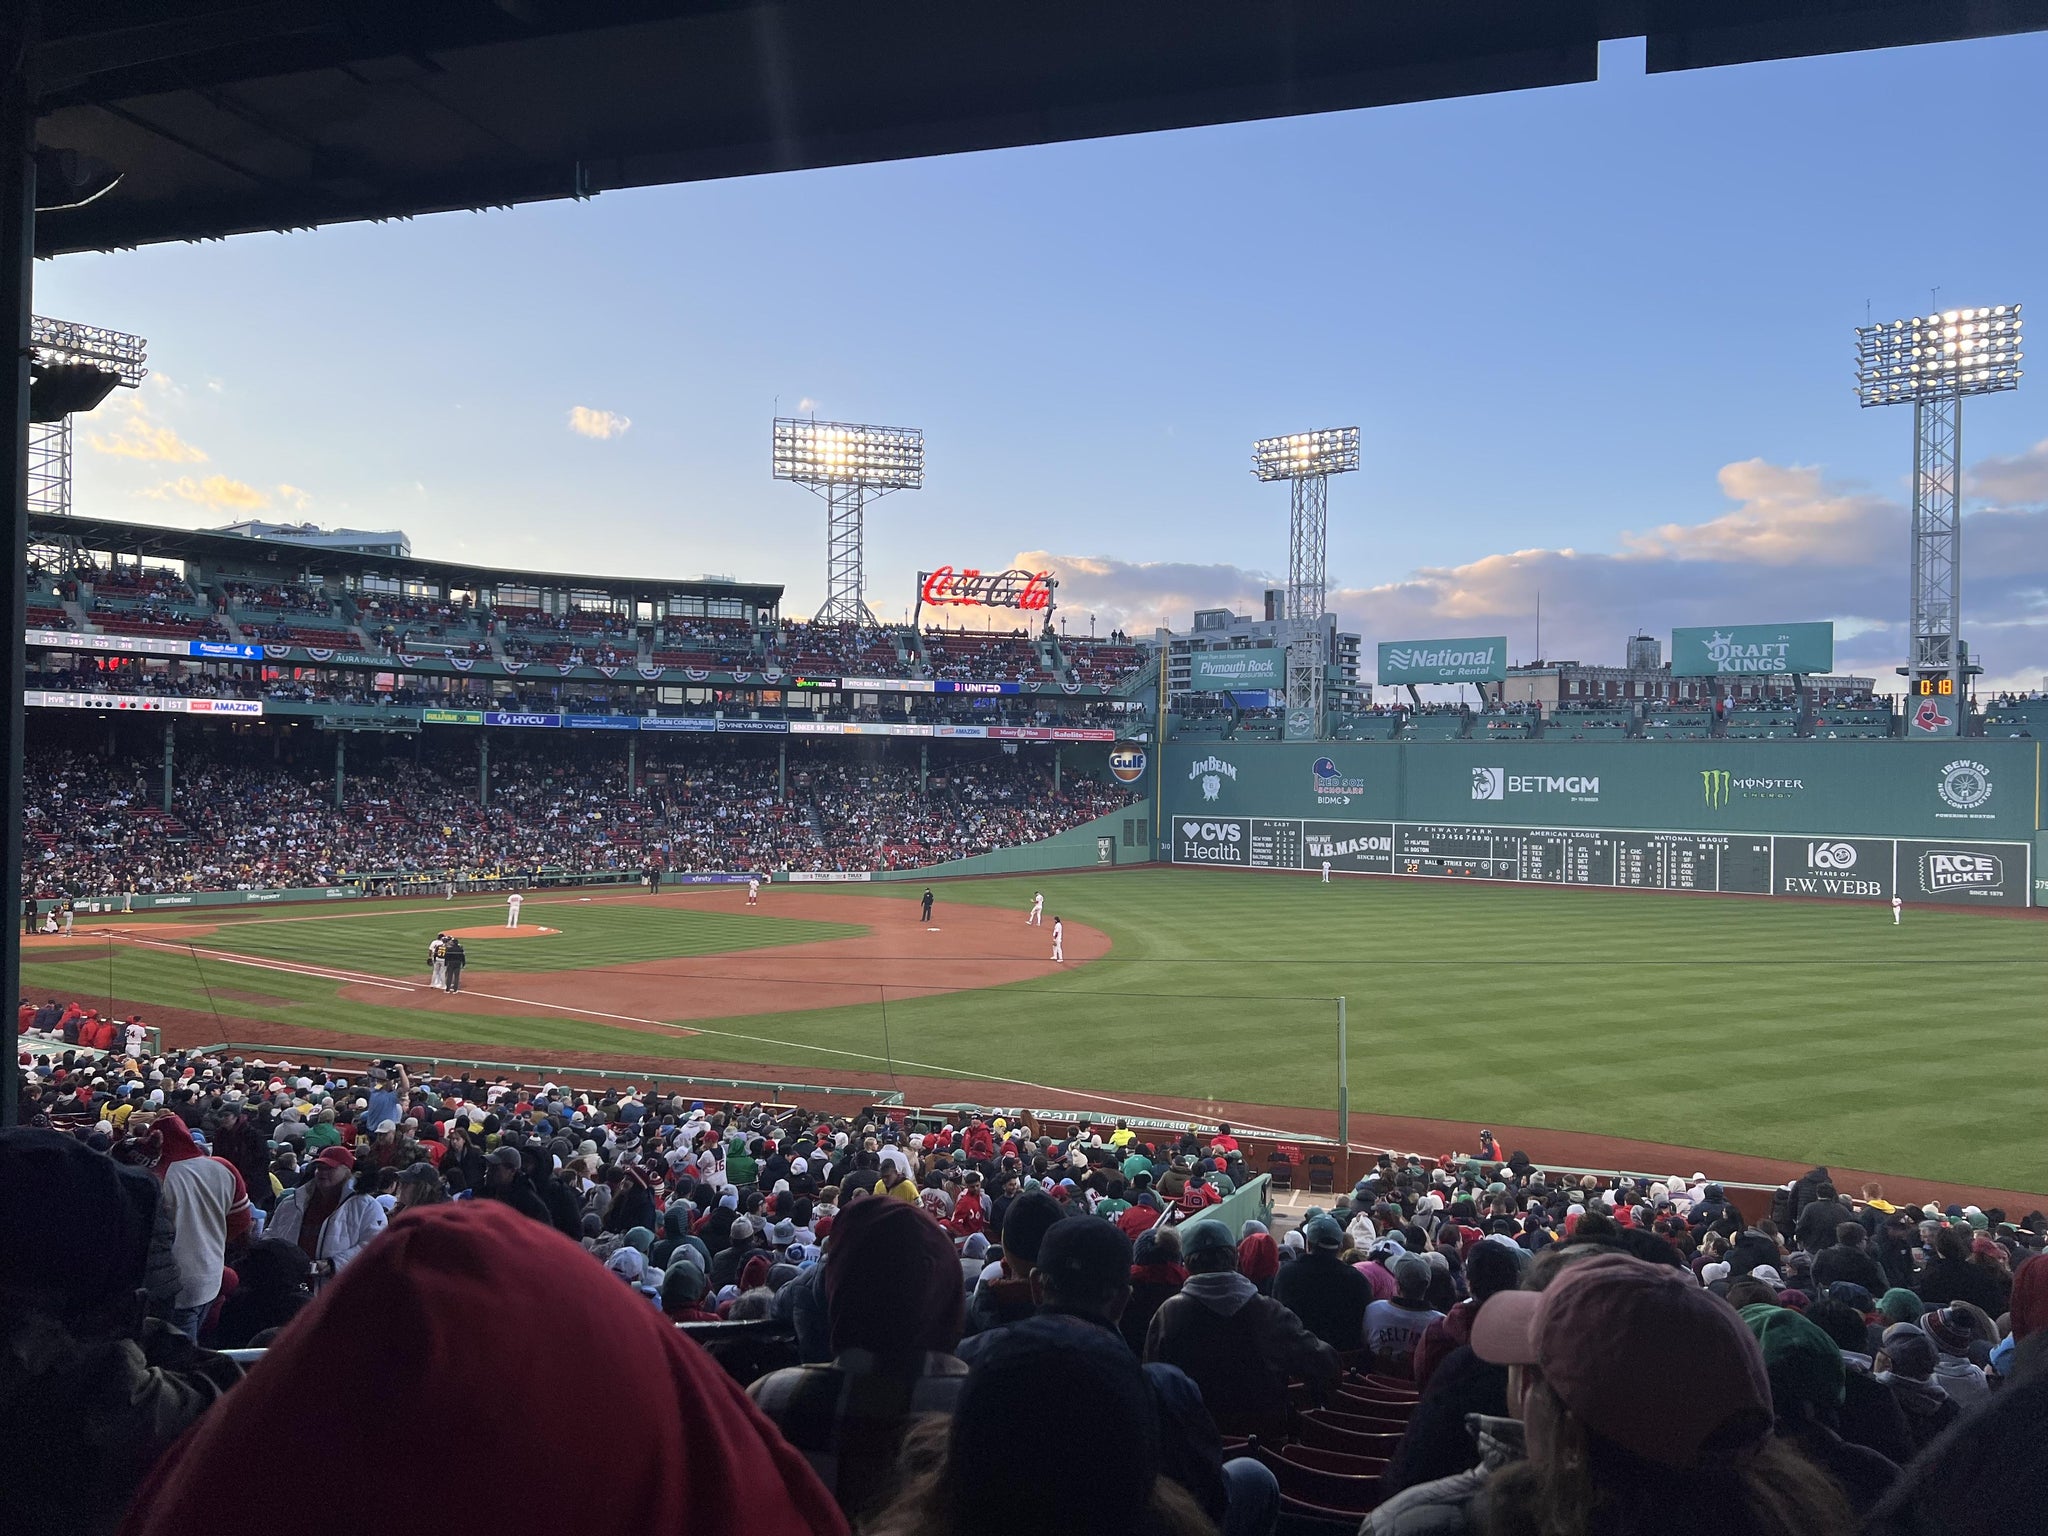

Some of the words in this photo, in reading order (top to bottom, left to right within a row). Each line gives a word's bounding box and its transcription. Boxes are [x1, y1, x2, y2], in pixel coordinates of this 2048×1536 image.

[1411, 647, 1494, 667] National
[1708, 643, 1789, 661] DRAFT
[361, 657, 392, 665] PAVILION
[1200, 661, 1245, 674] Plymouth
[1248, 660, 1273, 672] Rock
[1718, 658, 1787, 672] KINGS
[1458, 667, 1489, 675] Rental
[965, 683, 1001, 693] UNITED
[214, 703, 259, 712] AMAZING
[513, 716, 545, 725] HYCU
[1110, 755, 1143, 768] Gulf
[1208, 755, 1238, 781] BEAM
[1941, 760, 1970, 775] IBEW
[1971, 761, 1990, 776] 103
[1318, 779, 1340, 787] RED
[1342, 779, 1364, 787] SOX
[1508, 776, 1599, 793] BETMGM
[1733, 778, 1804, 789] MONSTER
[1318, 797, 1341, 805] BIDMC
[1947, 783, 1993, 809] CONTRACTORS
[1201, 823, 1241, 842] CVS
[1184, 841, 1241, 860] Health
[1808, 842, 1857, 869] 160
[1407, 864, 1418, 873] 22
[1936, 855, 1993, 873] ACE
[692, 875, 711, 883] xfinity
[1936, 872, 1993, 884] TICKET
[1785, 878, 1817, 892] F.W.
[1823, 879, 1881, 895] WEBB
[715, 1160, 725, 1172] 16
